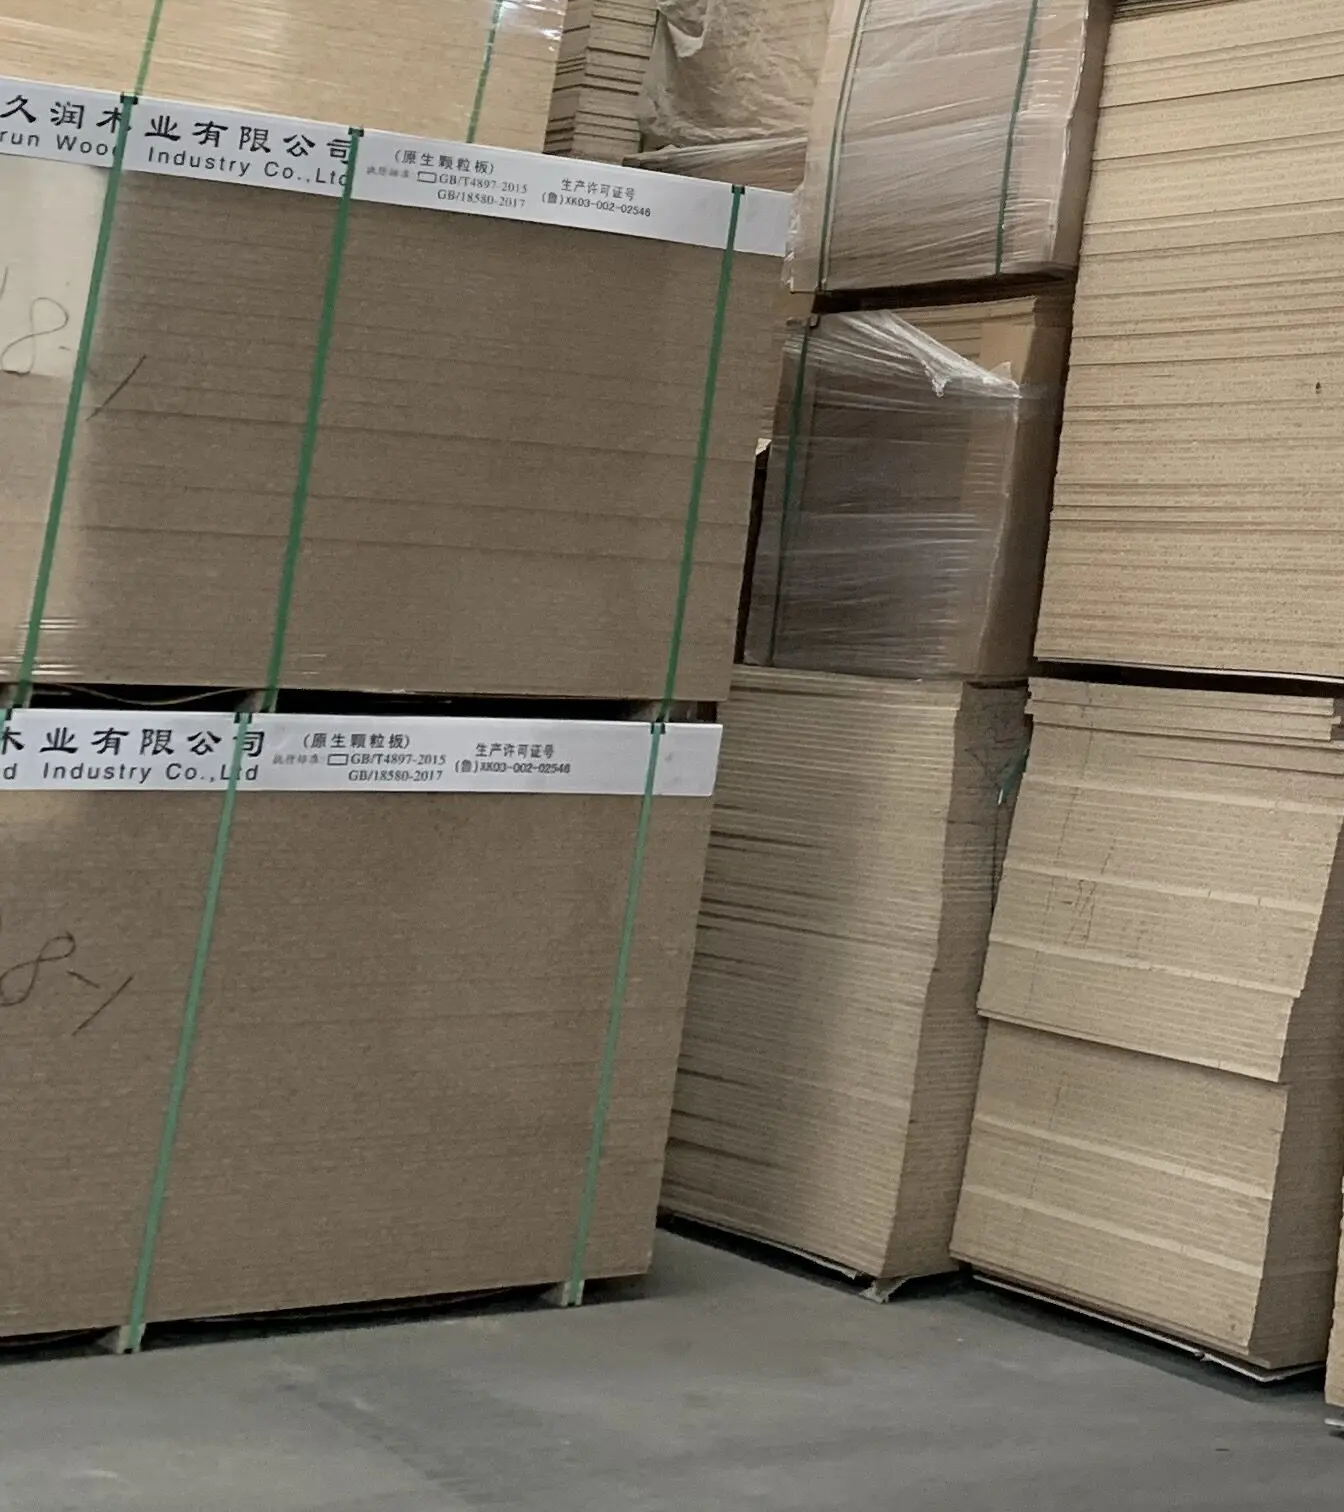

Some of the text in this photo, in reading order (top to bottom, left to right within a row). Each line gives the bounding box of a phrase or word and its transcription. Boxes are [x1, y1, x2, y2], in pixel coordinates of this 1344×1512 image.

[56, 133, 119, 157] Woo
[148, 146, 250, 177] Industry
[560, 178, 636, 202] 生产许可证号
[475, 742, 556, 759] 生产许可证号
[43, 762, 152, 785] Industry
